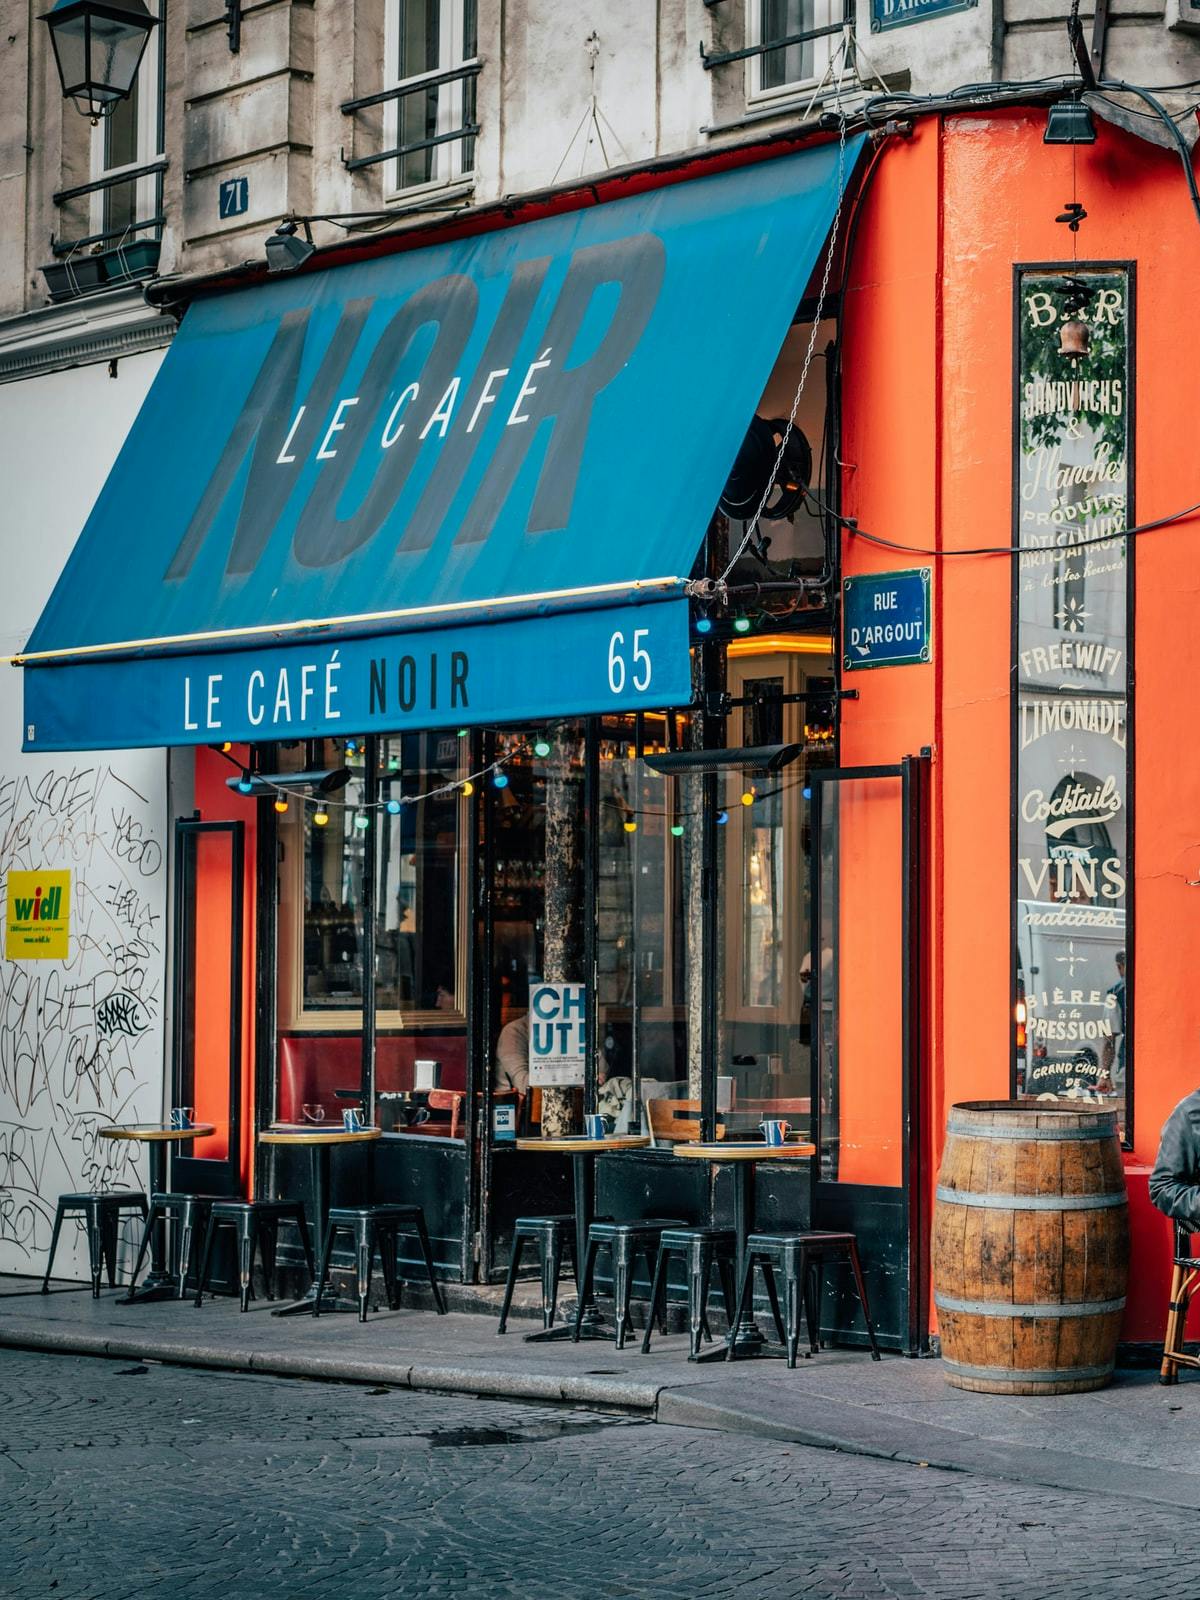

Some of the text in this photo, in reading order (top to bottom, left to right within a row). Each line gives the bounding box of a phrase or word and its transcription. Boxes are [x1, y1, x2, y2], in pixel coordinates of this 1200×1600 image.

[225, 182, 242, 214] 71
[163, 232, 667, 580] NOIR
[276, 347, 552, 464] LE CAFÉ
[1066, 416, 1085, 440] &
[1022, 493, 1125, 526] PRODUITS
[873, 591, 898, 611] RUE
[851, 621, 923, 646] D'ARGOUT
[608, 628, 652, 694] 65
[1020, 643, 1122, 678] FREE WIFI
[184, 649, 470, 731] LE CAFÉ NOIR
[1021, 699, 1127, 751] LIMONADE
[1022, 774, 1122, 823] Cocktails
[1018, 857, 1127, 899] VINS
[14, 886, 62, 921] widl
[533, 987, 586, 1020] CH
[1024, 987, 1118, 1010] BIÈRES
[533, 1022, 586, 1056] UT!
[1025, 1016, 1112, 1041] PRESSION
[1032, 1062, 1110, 1080] GRAND CHOIX
[1065, 1078, 1081, 1087] DE
